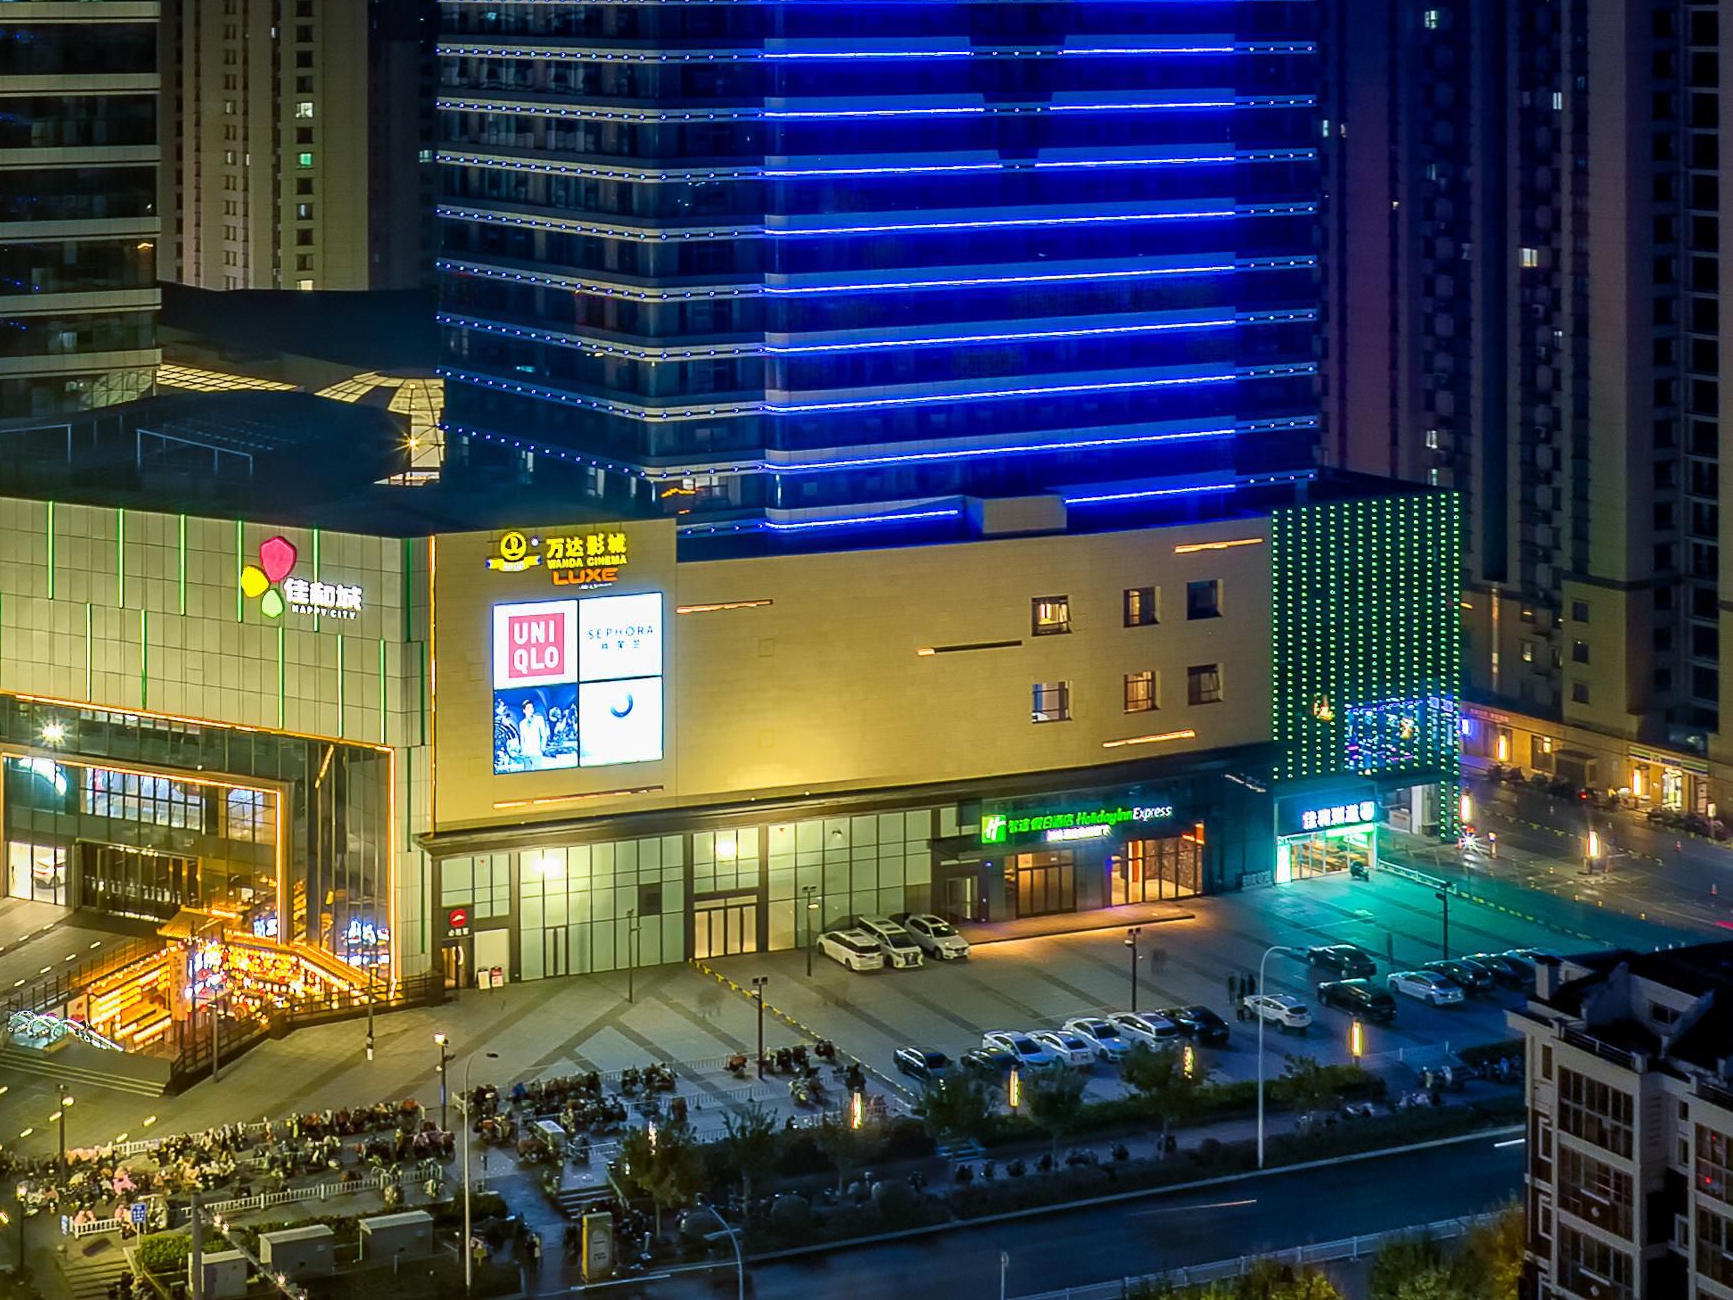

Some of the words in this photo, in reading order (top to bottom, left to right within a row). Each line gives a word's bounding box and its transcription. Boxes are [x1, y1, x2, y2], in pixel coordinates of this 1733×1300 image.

[546, 557, 584, 570] WANDA
[586, 555, 628, 567] CINEMA
[552, 568, 619, 586] LUXE
[329, 609, 357, 620] CITY
[513, 620, 555, 645] UNI
[588, 625, 654, 640] SEPHORA
[513, 646, 560, 674] QLO
[1132, 806, 1173, 822] Express
